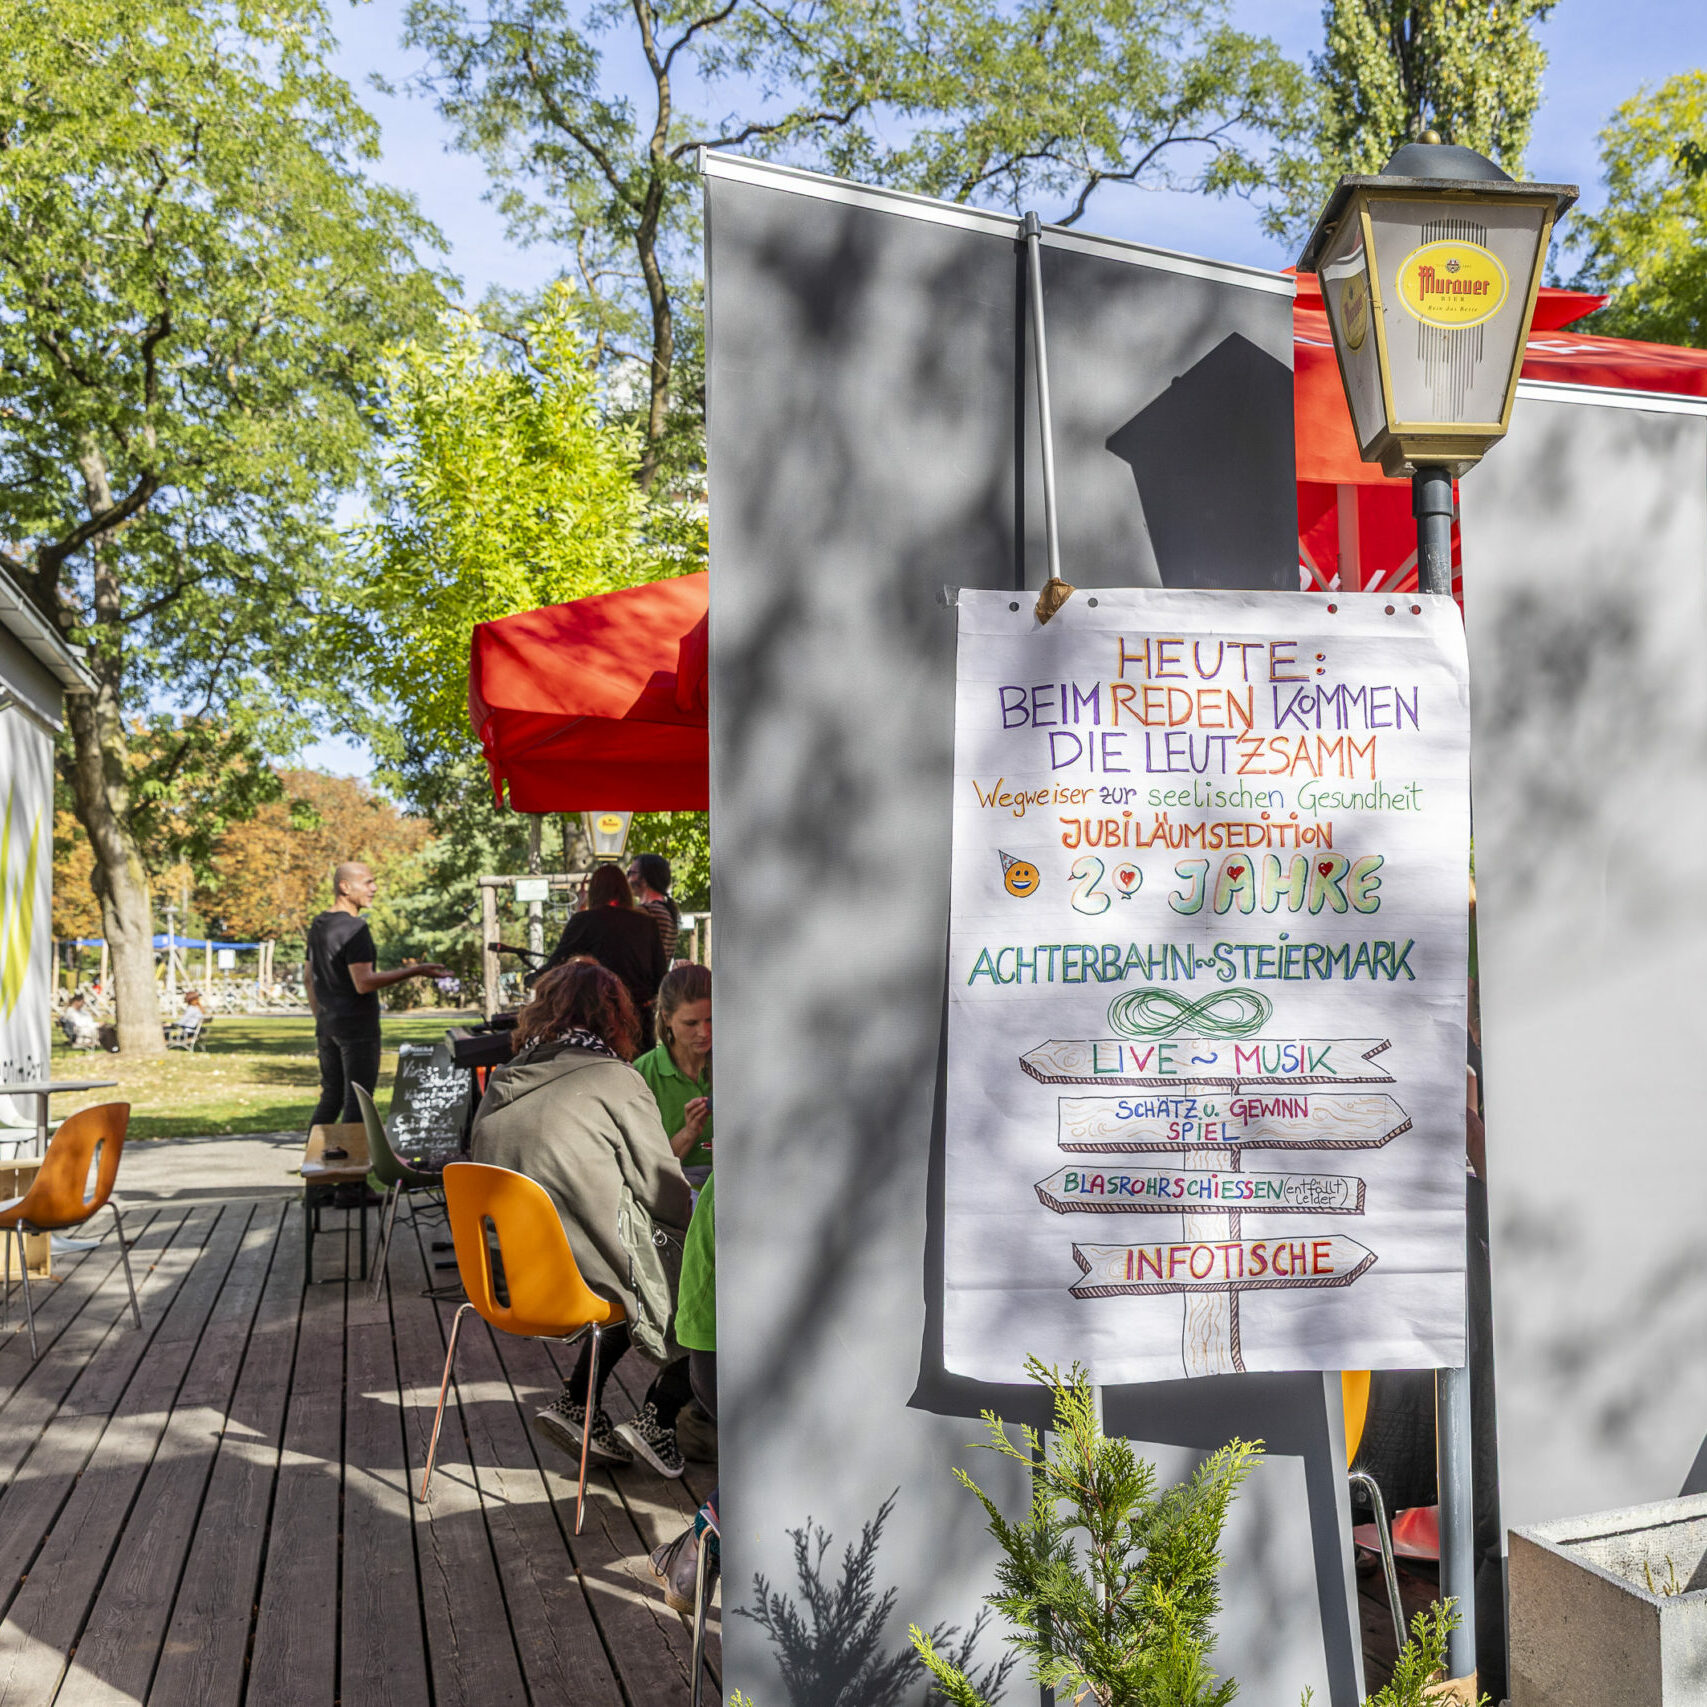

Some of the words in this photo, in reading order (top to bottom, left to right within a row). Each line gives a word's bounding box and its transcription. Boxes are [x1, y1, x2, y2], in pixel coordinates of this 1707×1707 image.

[1418, 265, 1490, 302] Murauer
[1118, 636, 1327, 682] HEUTE:
[999, 682, 1101, 729] BEIM
[1110, 684, 1254, 730] REDEN
[1048, 731, 1130, 773] DIE
[972, 778, 1097, 818] Wegweiser
[1098, 786, 1138, 807] zur
[1147, 779, 1286, 810] seelischen
[1297, 780, 1424, 817] Gesundheit
[1067, 855, 1144, 916] 20
[1168, 853, 1386, 916] JAHRE
[1092, 1044, 1179, 1076] LIVE
[1234, 1044, 1339, 1076] MUSIK
[1229, 1096, 1309, 1127] GEWINN
[1124, 1241, 1336, 1281] INFOTISCHE
